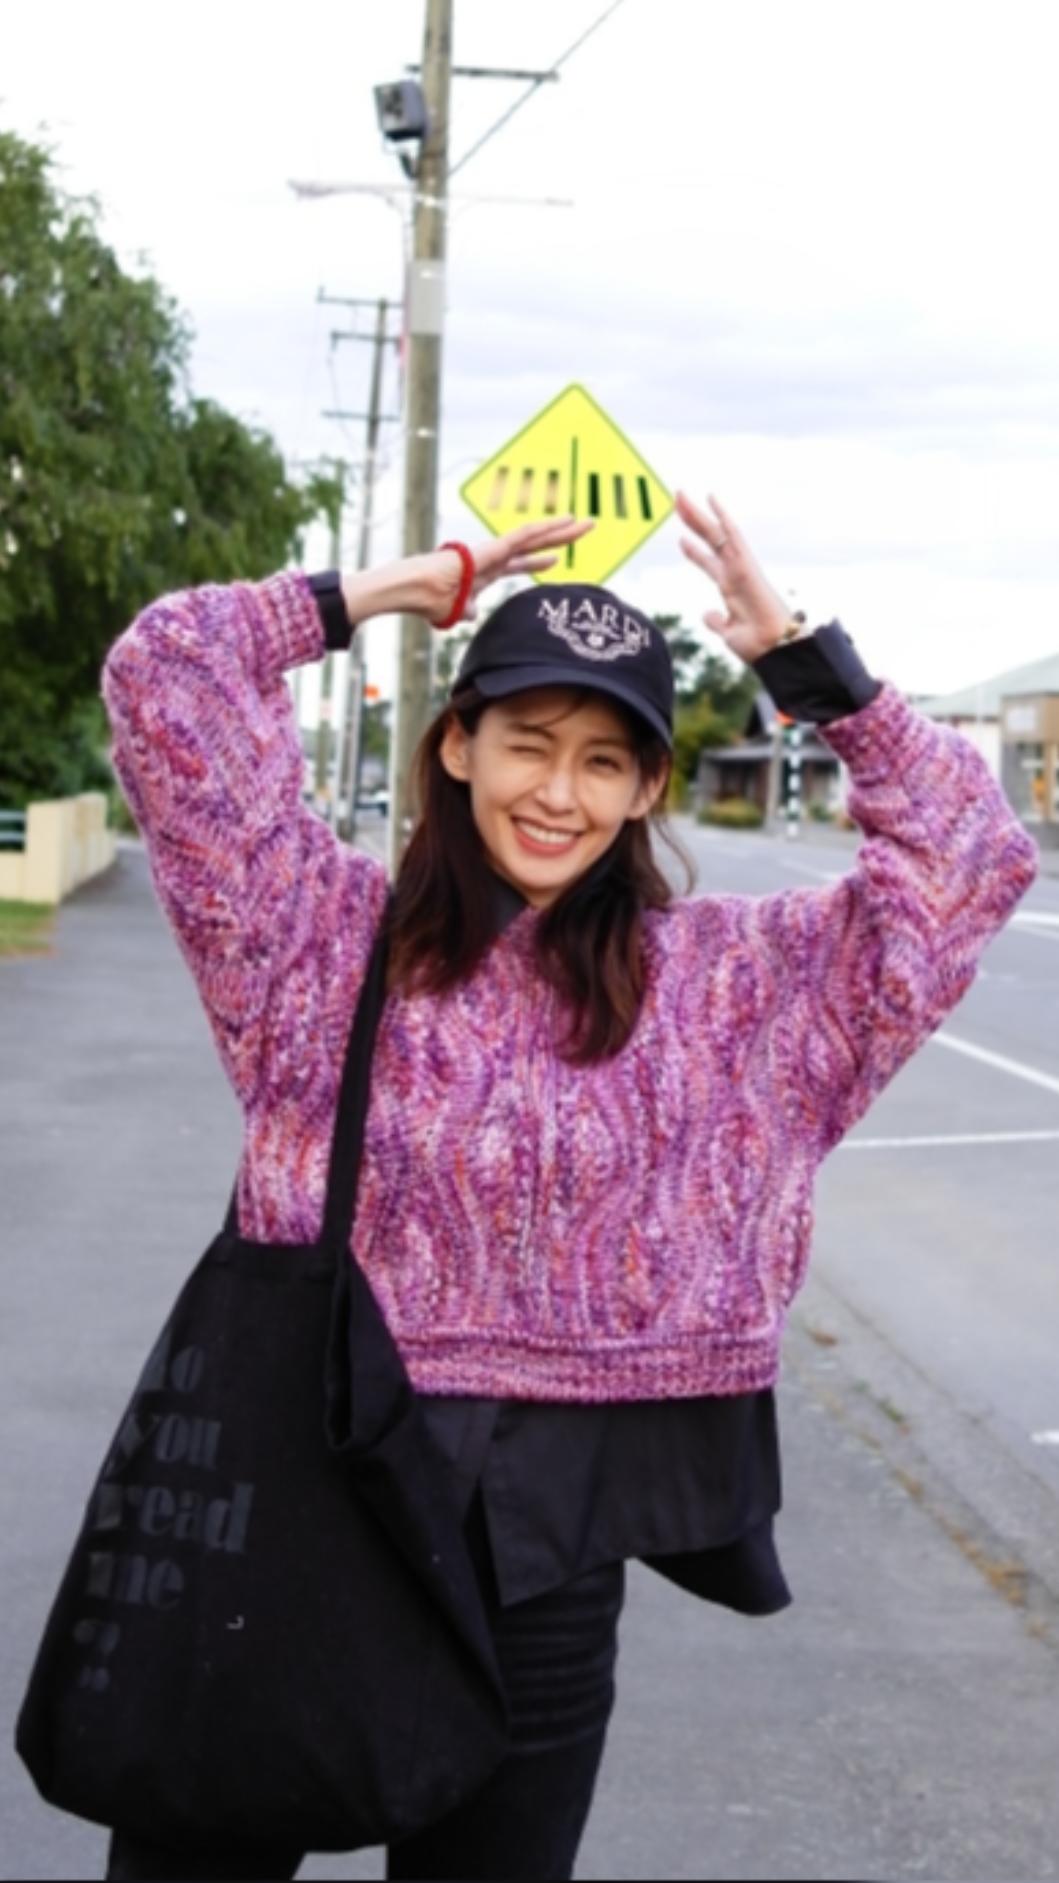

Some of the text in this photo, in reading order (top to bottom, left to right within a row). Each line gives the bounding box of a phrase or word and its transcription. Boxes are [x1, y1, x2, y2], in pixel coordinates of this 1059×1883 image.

[102, 1411, 222, 1477] you
[93, 1482, 255, 1555] read
[85, 1551, 185, 1611] me
